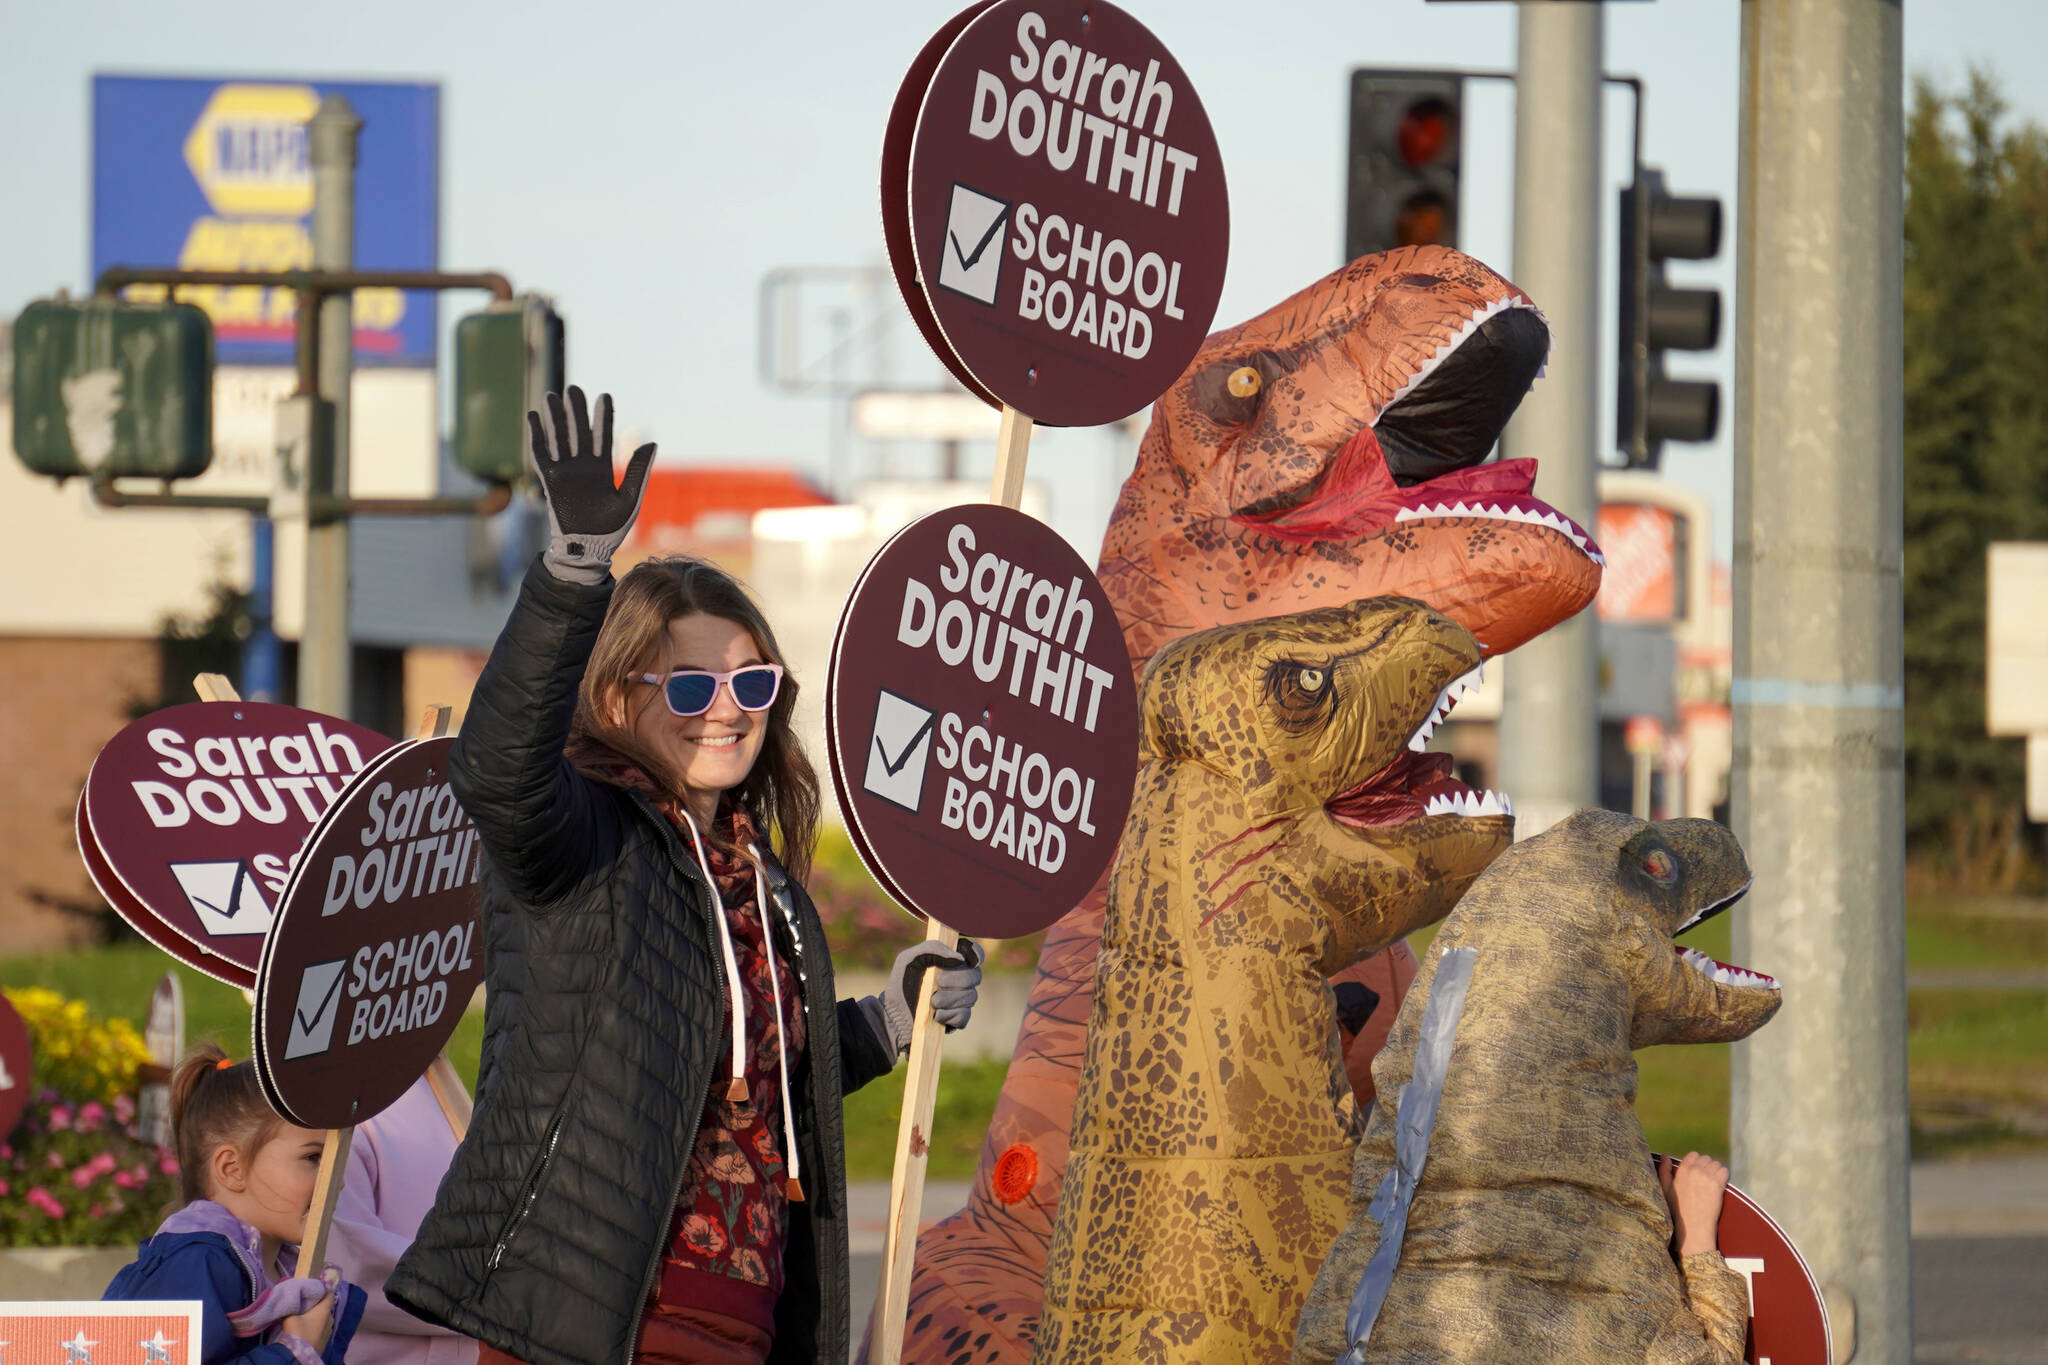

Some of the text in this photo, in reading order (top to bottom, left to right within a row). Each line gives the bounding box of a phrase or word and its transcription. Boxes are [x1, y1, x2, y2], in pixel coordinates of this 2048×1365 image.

[1010, 11, 1174, 137] Sarah
[968, 69, 1198, 216] DOUTHIT
[1012, 202, 1185, 321] SCHOOL
[1018, 267, 1153, 360] BOARD
[940, 523, 1094, 654] Sarah
[897, 577, 1115, 734] DOUTHIT
[146, 722, 364, 778] Sarah
[936, 711, 1097, 838] SCHOOL
[131, 774, 356, 828] DOUT
[360, 781, 475, 848] Sara
[940, 776, 1067, 875] BOARD
[347, 921, 473, 998] SCHOOL
[346, 980, 448, 1047] BOARD
